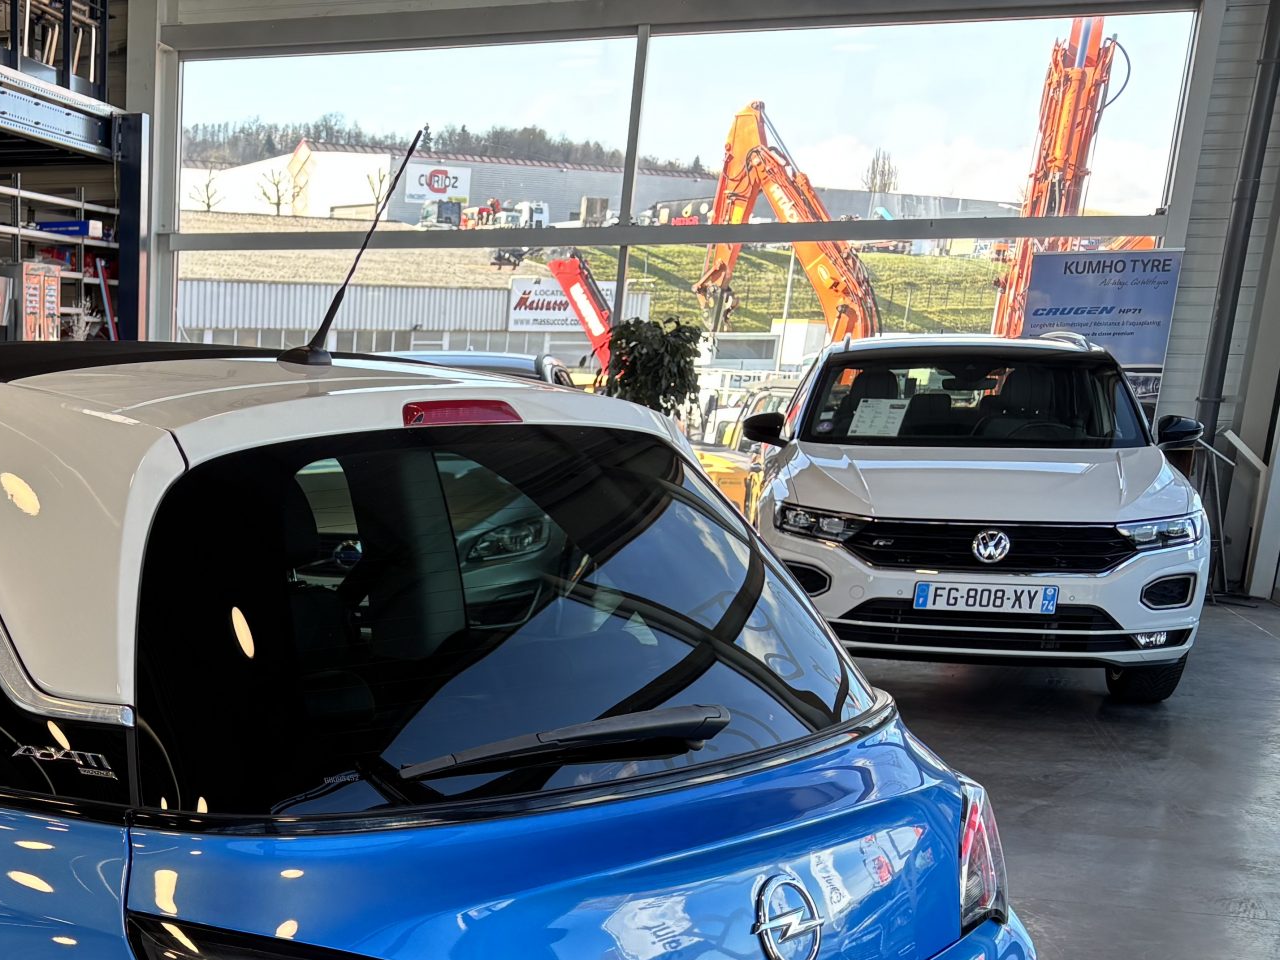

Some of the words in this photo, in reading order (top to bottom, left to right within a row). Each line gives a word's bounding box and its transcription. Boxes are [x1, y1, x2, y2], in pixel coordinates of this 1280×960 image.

[1064, 259, 1126, 275] KUMHO
[1130, 258, 1173, 273] TYRE
[1032, 306, 1117, 317] CRUGEN
[513, 317, 582, 326] www.massuccot.co
[932, 586, 1039, 610] FG-808-XY
[1042, 600, 1054, 612] 74
